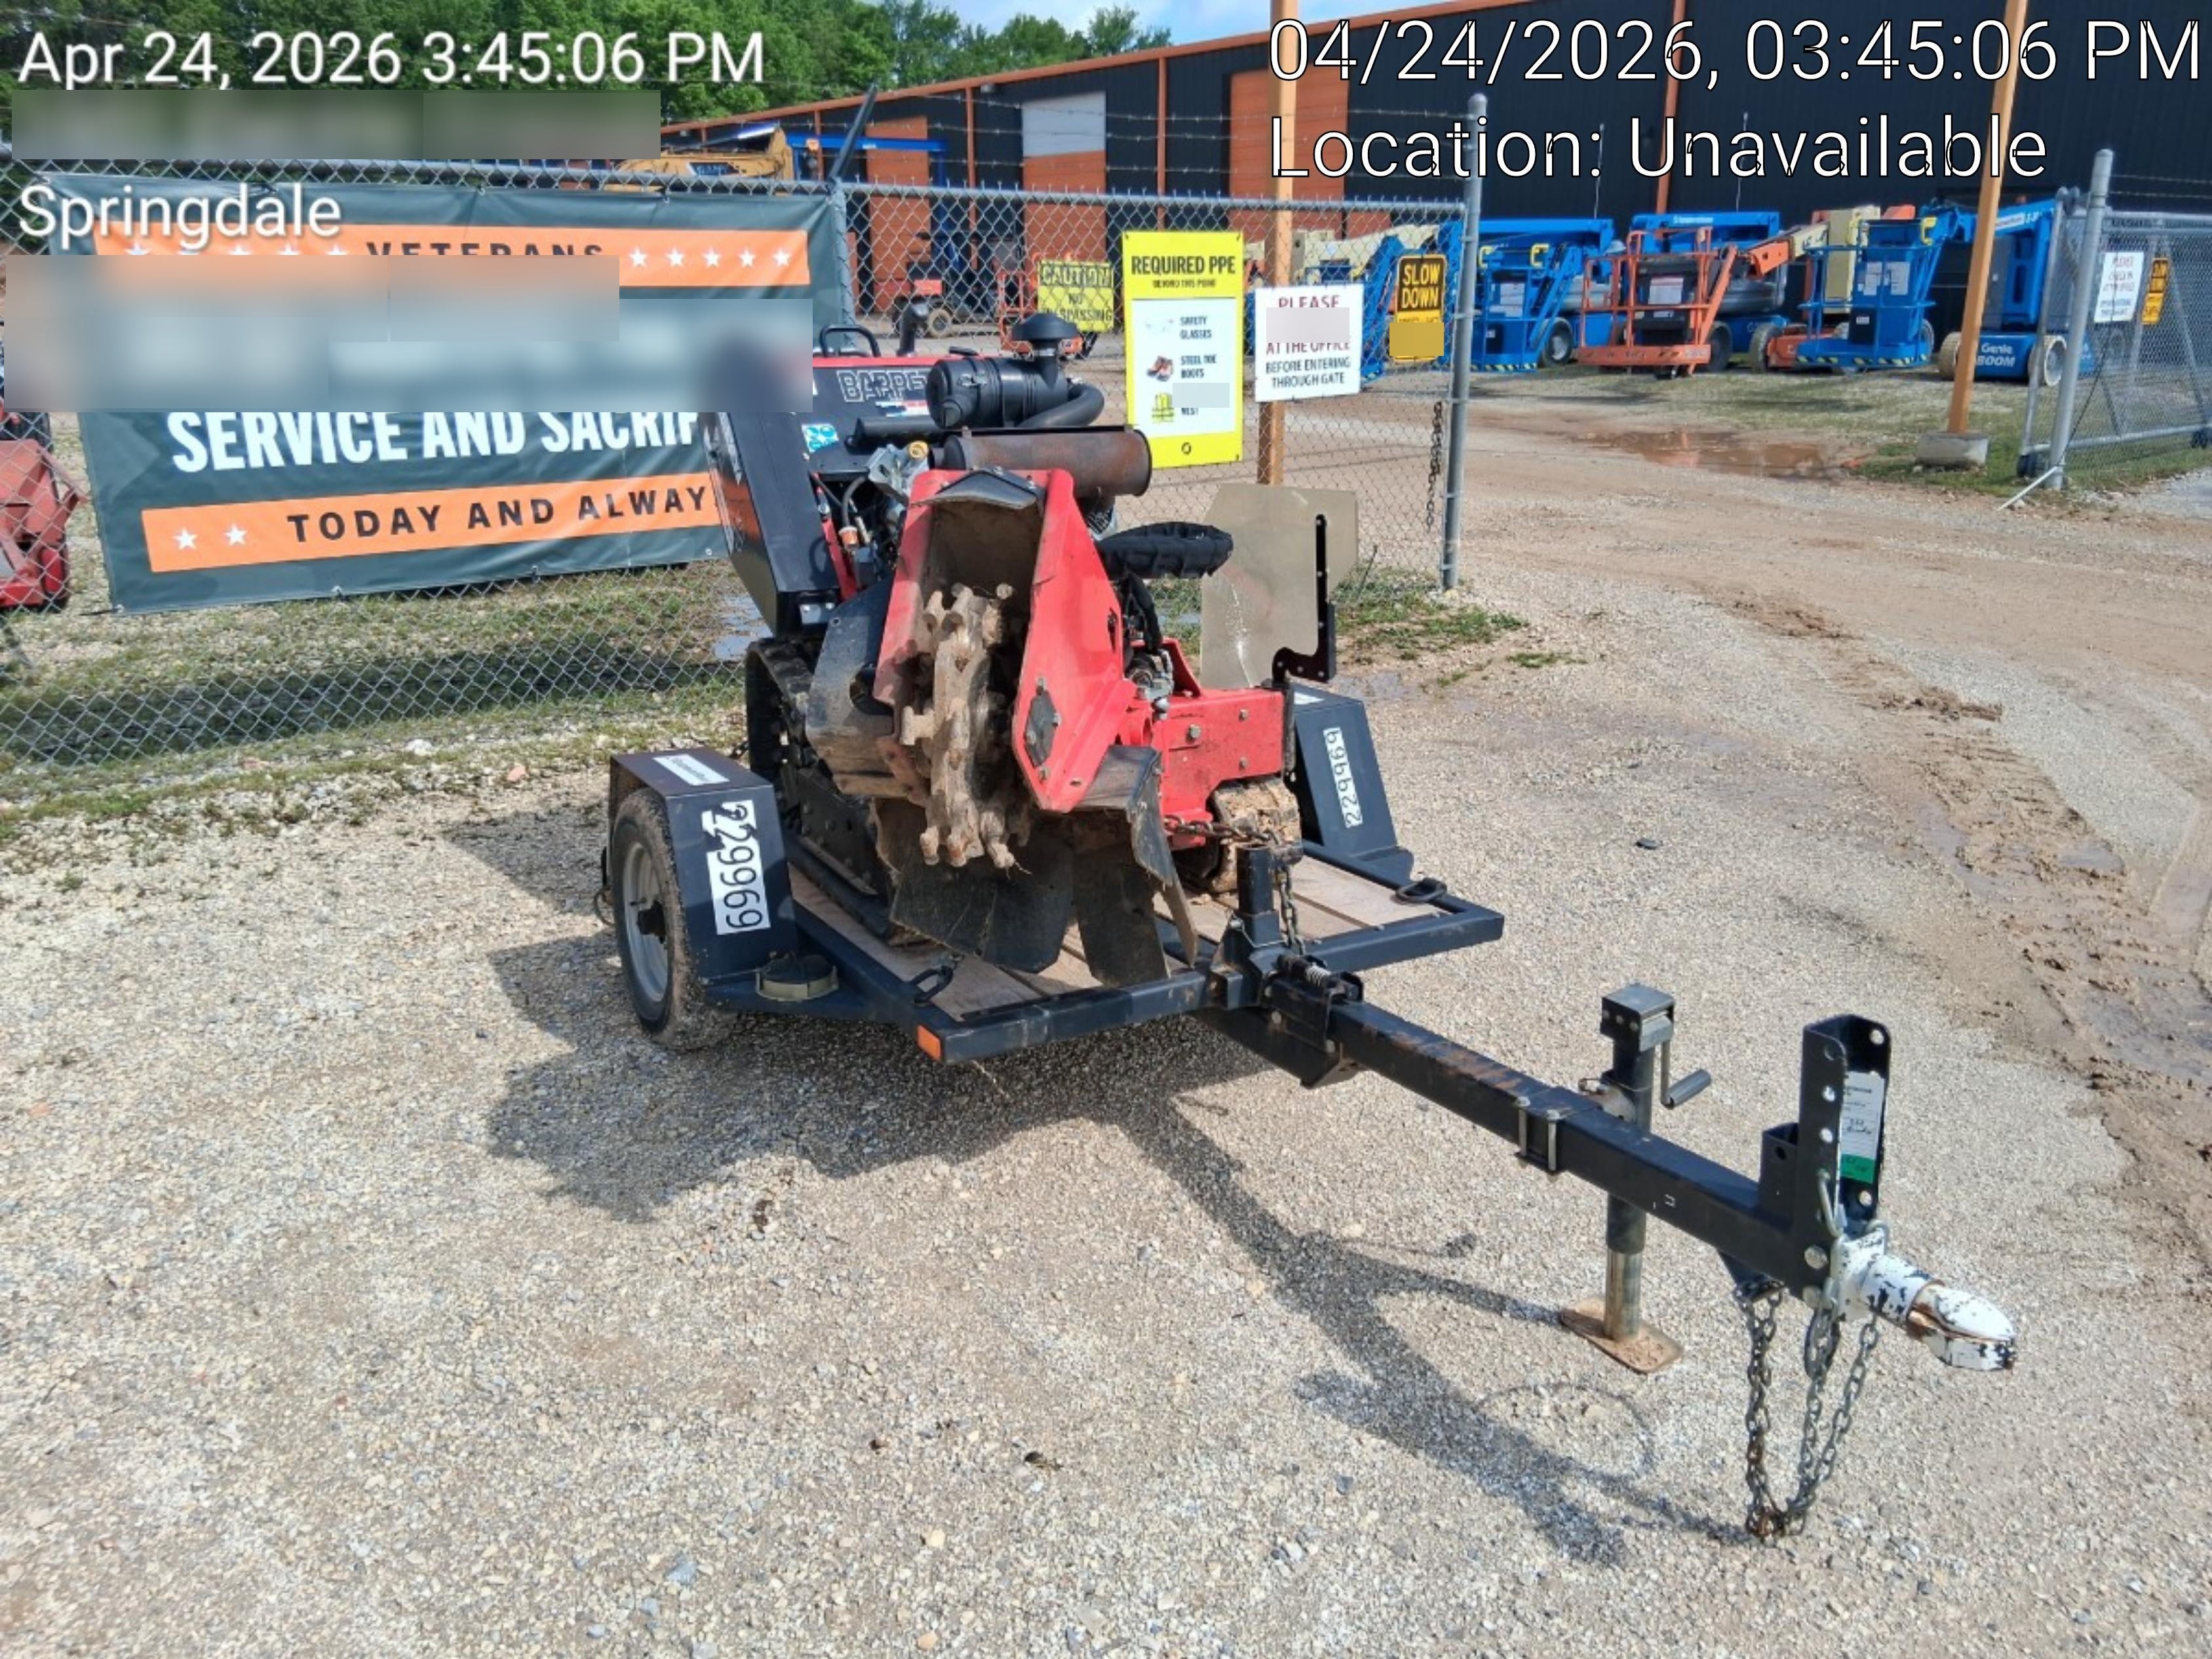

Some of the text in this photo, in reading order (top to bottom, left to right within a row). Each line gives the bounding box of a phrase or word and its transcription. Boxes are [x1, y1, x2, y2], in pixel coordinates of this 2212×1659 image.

[1043, 265, 1112, 286] CAUTION
[1132, 256, 1235, 275] REQUIRED PPE
[1403, 263, 1440, 286] SLOW
[1401, 286, 1438, 308] DOWN
[1286, 343, 1308, 354] THE
[1266, 357, 1351, 374] BEFORE ENTERING
[1977, 355, 2016, 368] BOOM
[1272, 372, 1345, 388] THROUGH GATE
[168, 412, 408, 473] SERVICE
[423, 412, 526, 458] AND
[287, 503, 440, 543] TODAY
[467, 497, 556, 530] AND
[1325, 730, 1361, 825] 229969
